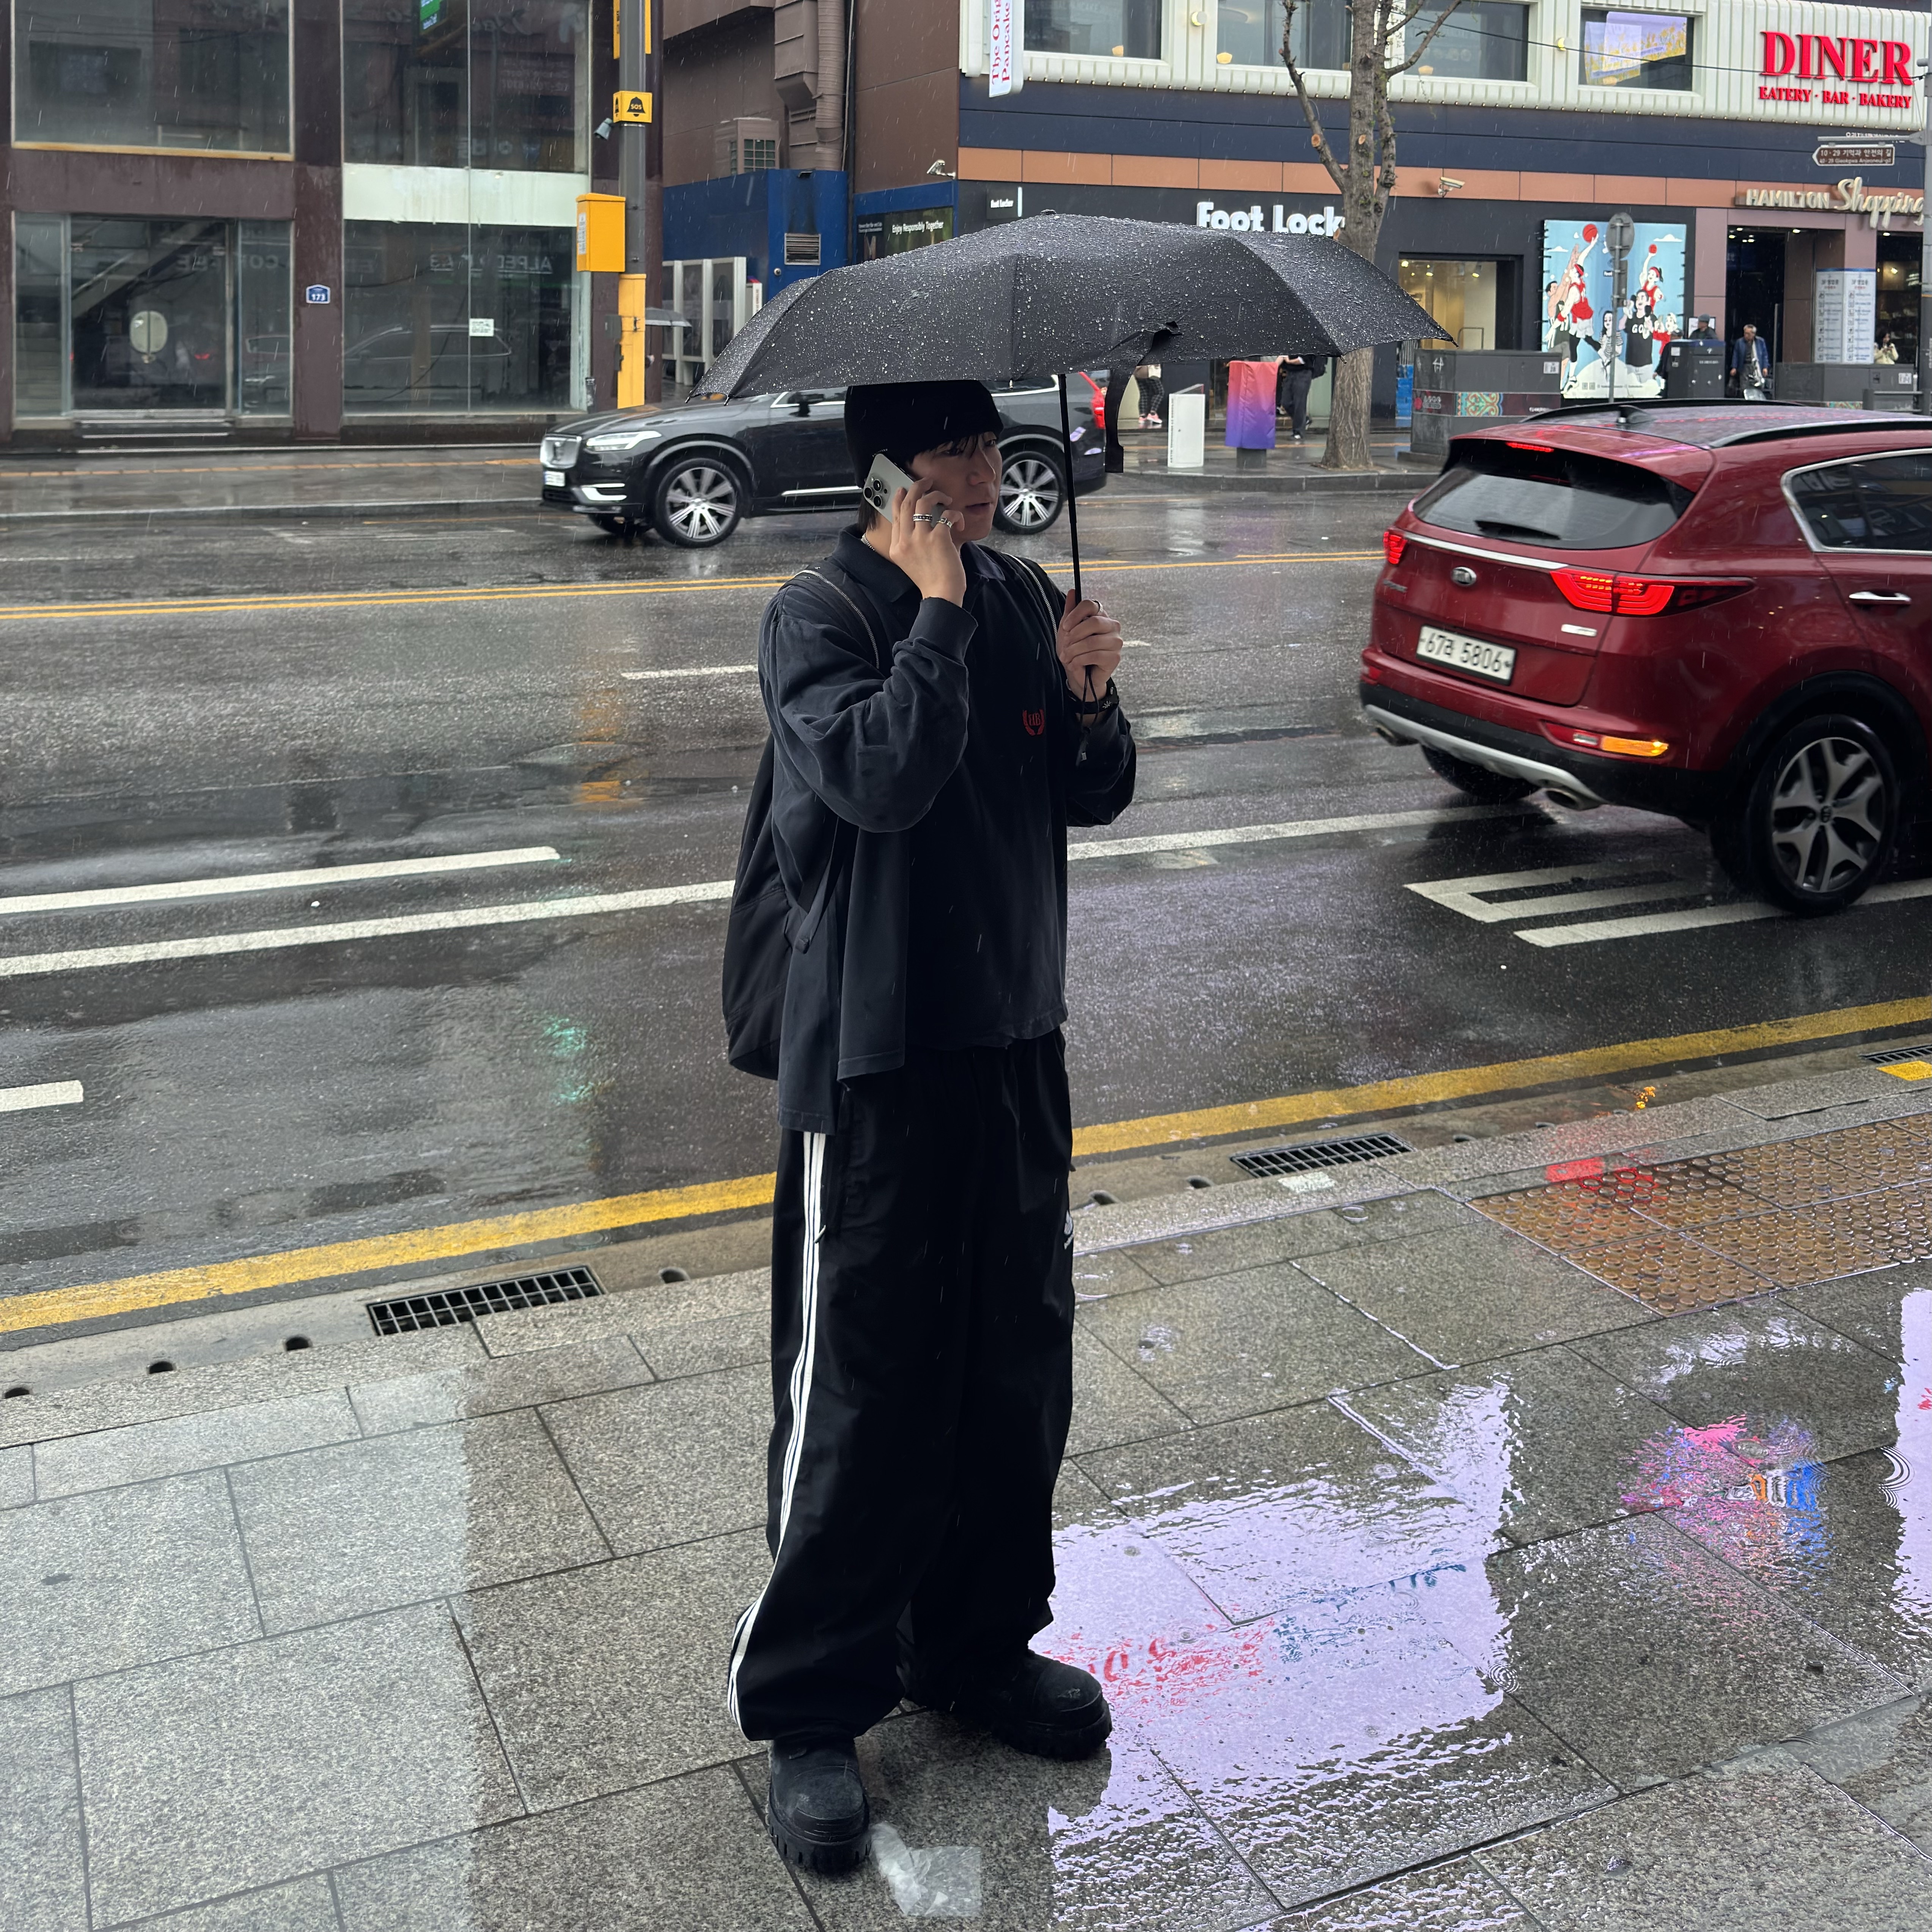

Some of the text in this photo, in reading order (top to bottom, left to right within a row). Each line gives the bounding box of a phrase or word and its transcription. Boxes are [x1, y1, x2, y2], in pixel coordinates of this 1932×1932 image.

[1001, 3, 1010, 83] Pancake
[1761, 30, 1914, 85] DINER
[992, 46, 1001, 85] The
[1759, 86, 1912, 108] EATERY BAR BAKERY
[1746, 189, 1830, 209] HAMILTON
[926, 220, 944, 232] Together
[1197, 201, 1346, 236] Foot Lock
[1460, 642, 1502, 672] 5806
